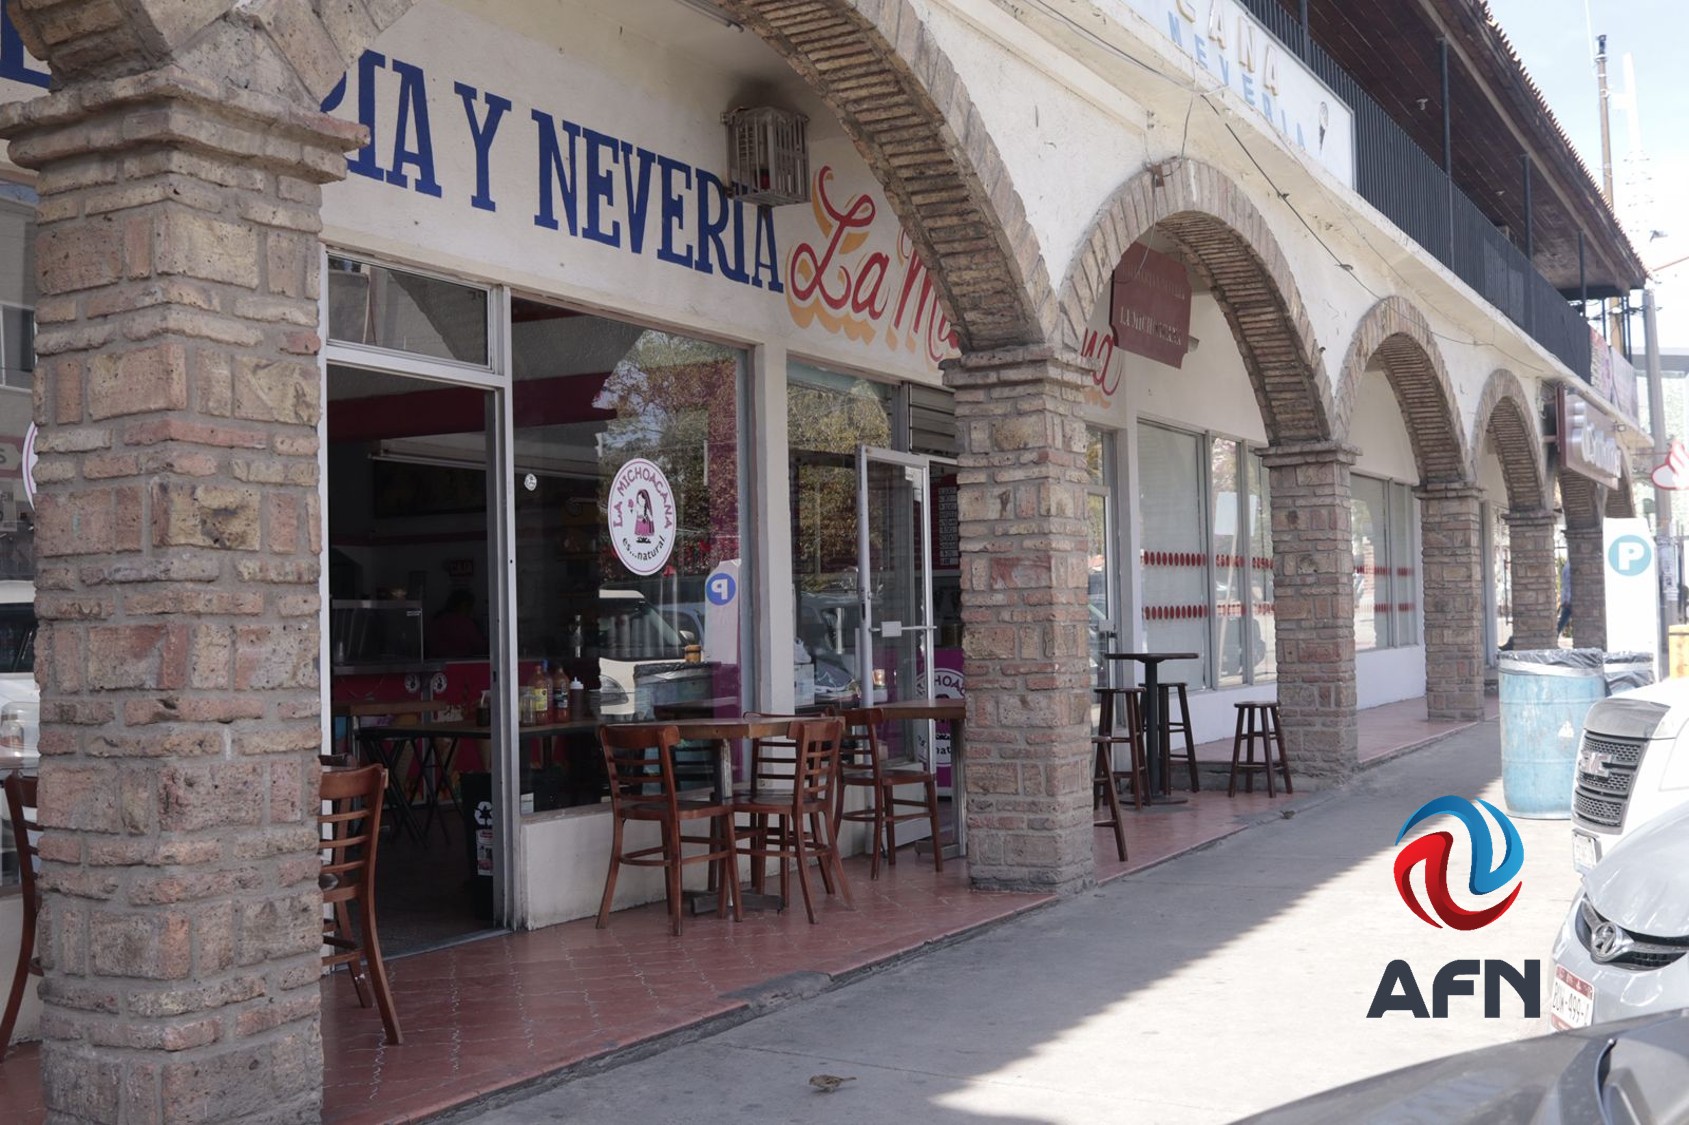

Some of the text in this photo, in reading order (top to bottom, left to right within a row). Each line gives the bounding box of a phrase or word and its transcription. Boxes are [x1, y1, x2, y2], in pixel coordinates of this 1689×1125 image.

[1168, 11, 1306, 151] NEVERIA
[454, 80, 512, 212] Y
[531, 108, 784, 293] NEVERIA
[790, 164, 890, 321] La
[613, 466, 673, 529] LA MICHOACANA
[1618, 542, 1644, 571] P
